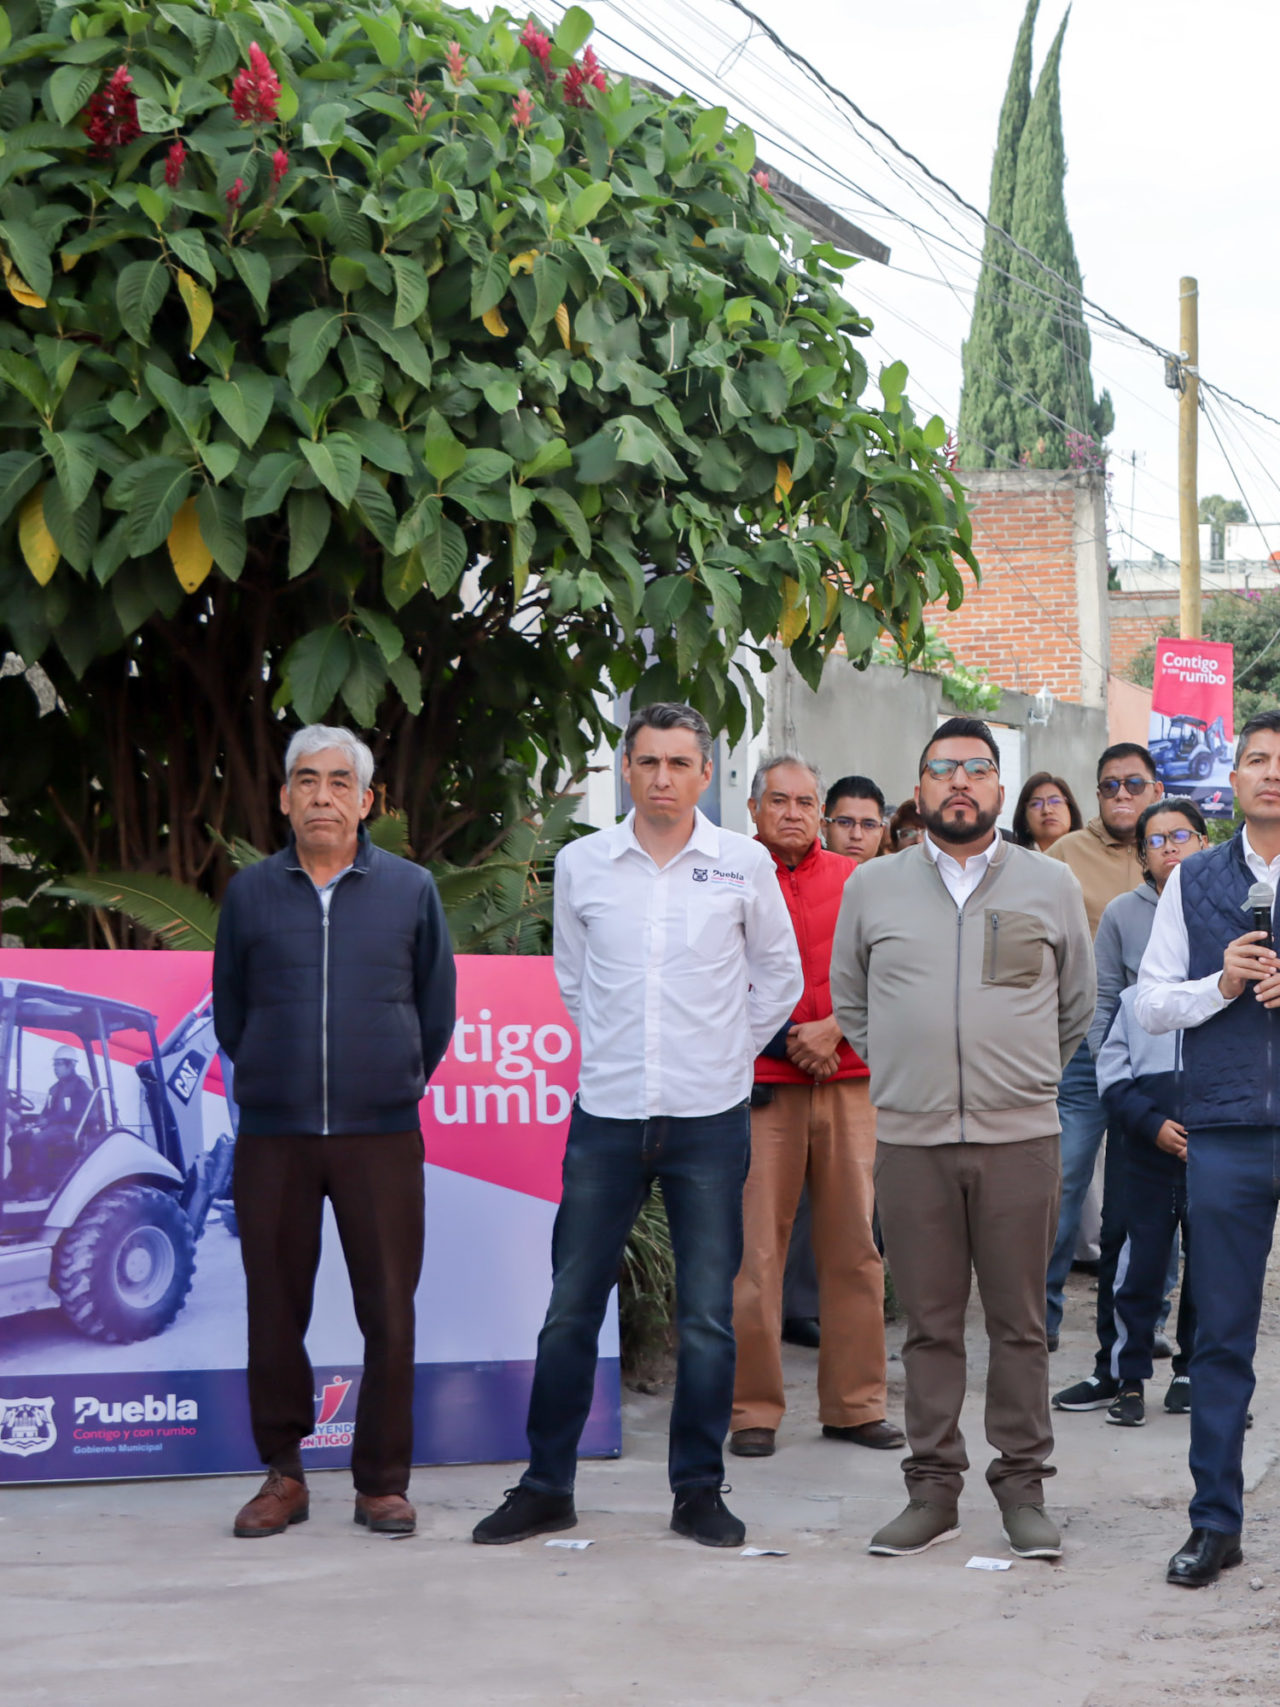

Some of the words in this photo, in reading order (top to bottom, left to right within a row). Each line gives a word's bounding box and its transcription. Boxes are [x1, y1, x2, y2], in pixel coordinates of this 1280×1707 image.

[1162, 652, 1219, 673] Contigo
[1180, 670, 1226, 685] rumbo
[713, 870, 744, 880] Puebla
[454, 1009, 572, 1080] tigo
[175, 1059, 198, 1098] CAT
[424, 1069, 576, 1124] umb
[74, 1394, 198, 1424] Puebla
[73, 1428, 121, 1441] Contigo
[124, 1430, 131, 1440] y
[134, 1428, 154, 1437] con
[157, 1426, 197, 1437] rumbo
[300, 1433, 351, 1448] ONTIGO
[73, 1445, 117, 1454] Gobierno
[118, 1443, 163, 1453] Municipal
